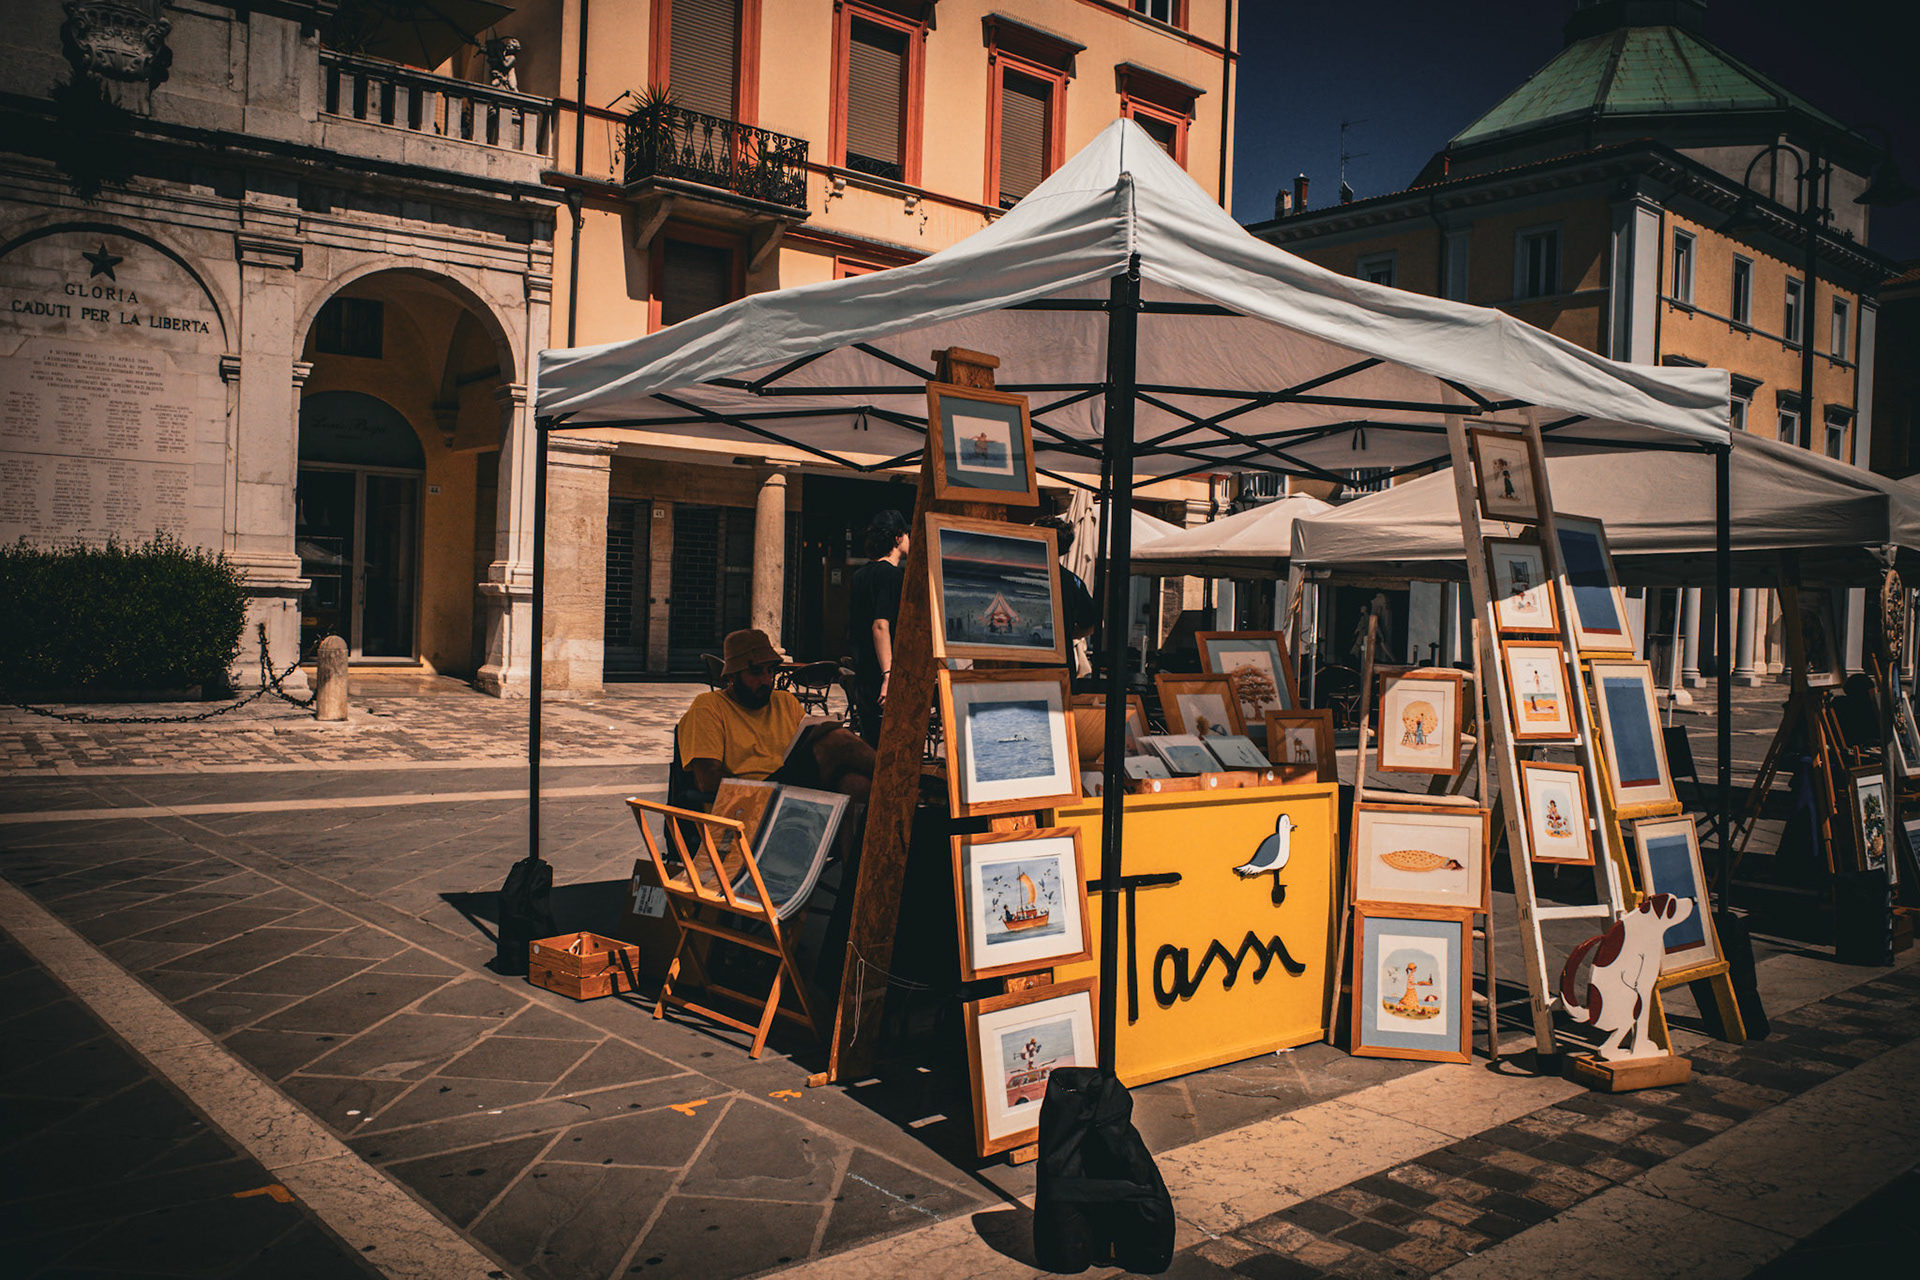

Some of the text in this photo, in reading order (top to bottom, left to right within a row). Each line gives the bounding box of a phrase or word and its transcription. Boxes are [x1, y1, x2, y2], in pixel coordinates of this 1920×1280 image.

[65, 283, 139, 304] GLORIA
[11, 300, 71, 318] CADUTI
[81, 307, 110, 322] PER
[120, 312, 141, 326] LA
